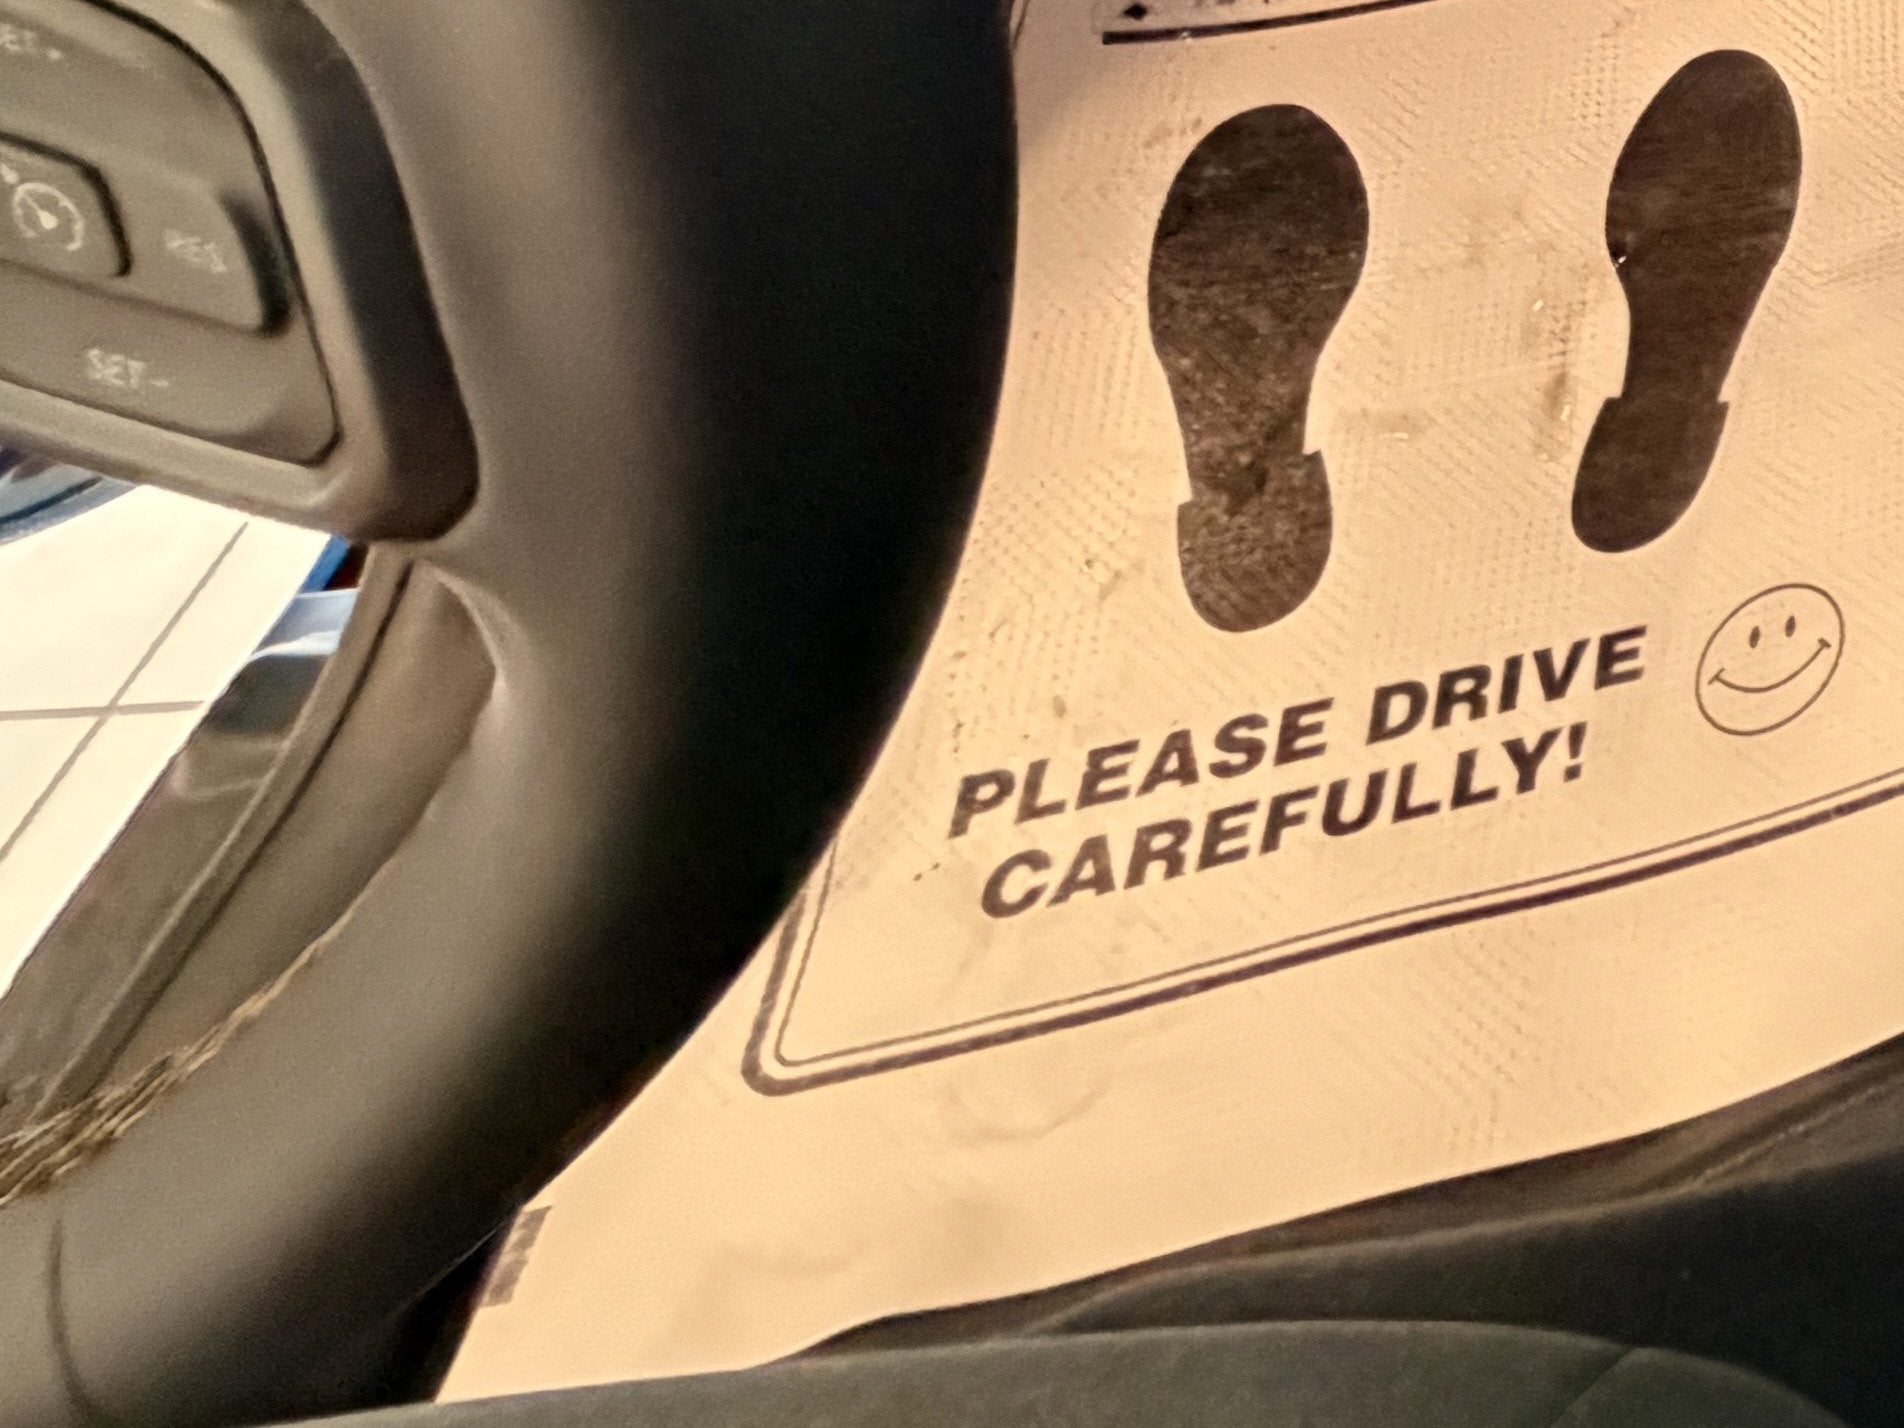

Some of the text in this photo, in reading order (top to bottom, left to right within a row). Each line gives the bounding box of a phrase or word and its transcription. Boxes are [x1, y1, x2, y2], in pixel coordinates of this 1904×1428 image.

[947, 624, 1648, 840] PLEASE DRIVE
[980, 720, 1589, 920] CAREFULLY!
